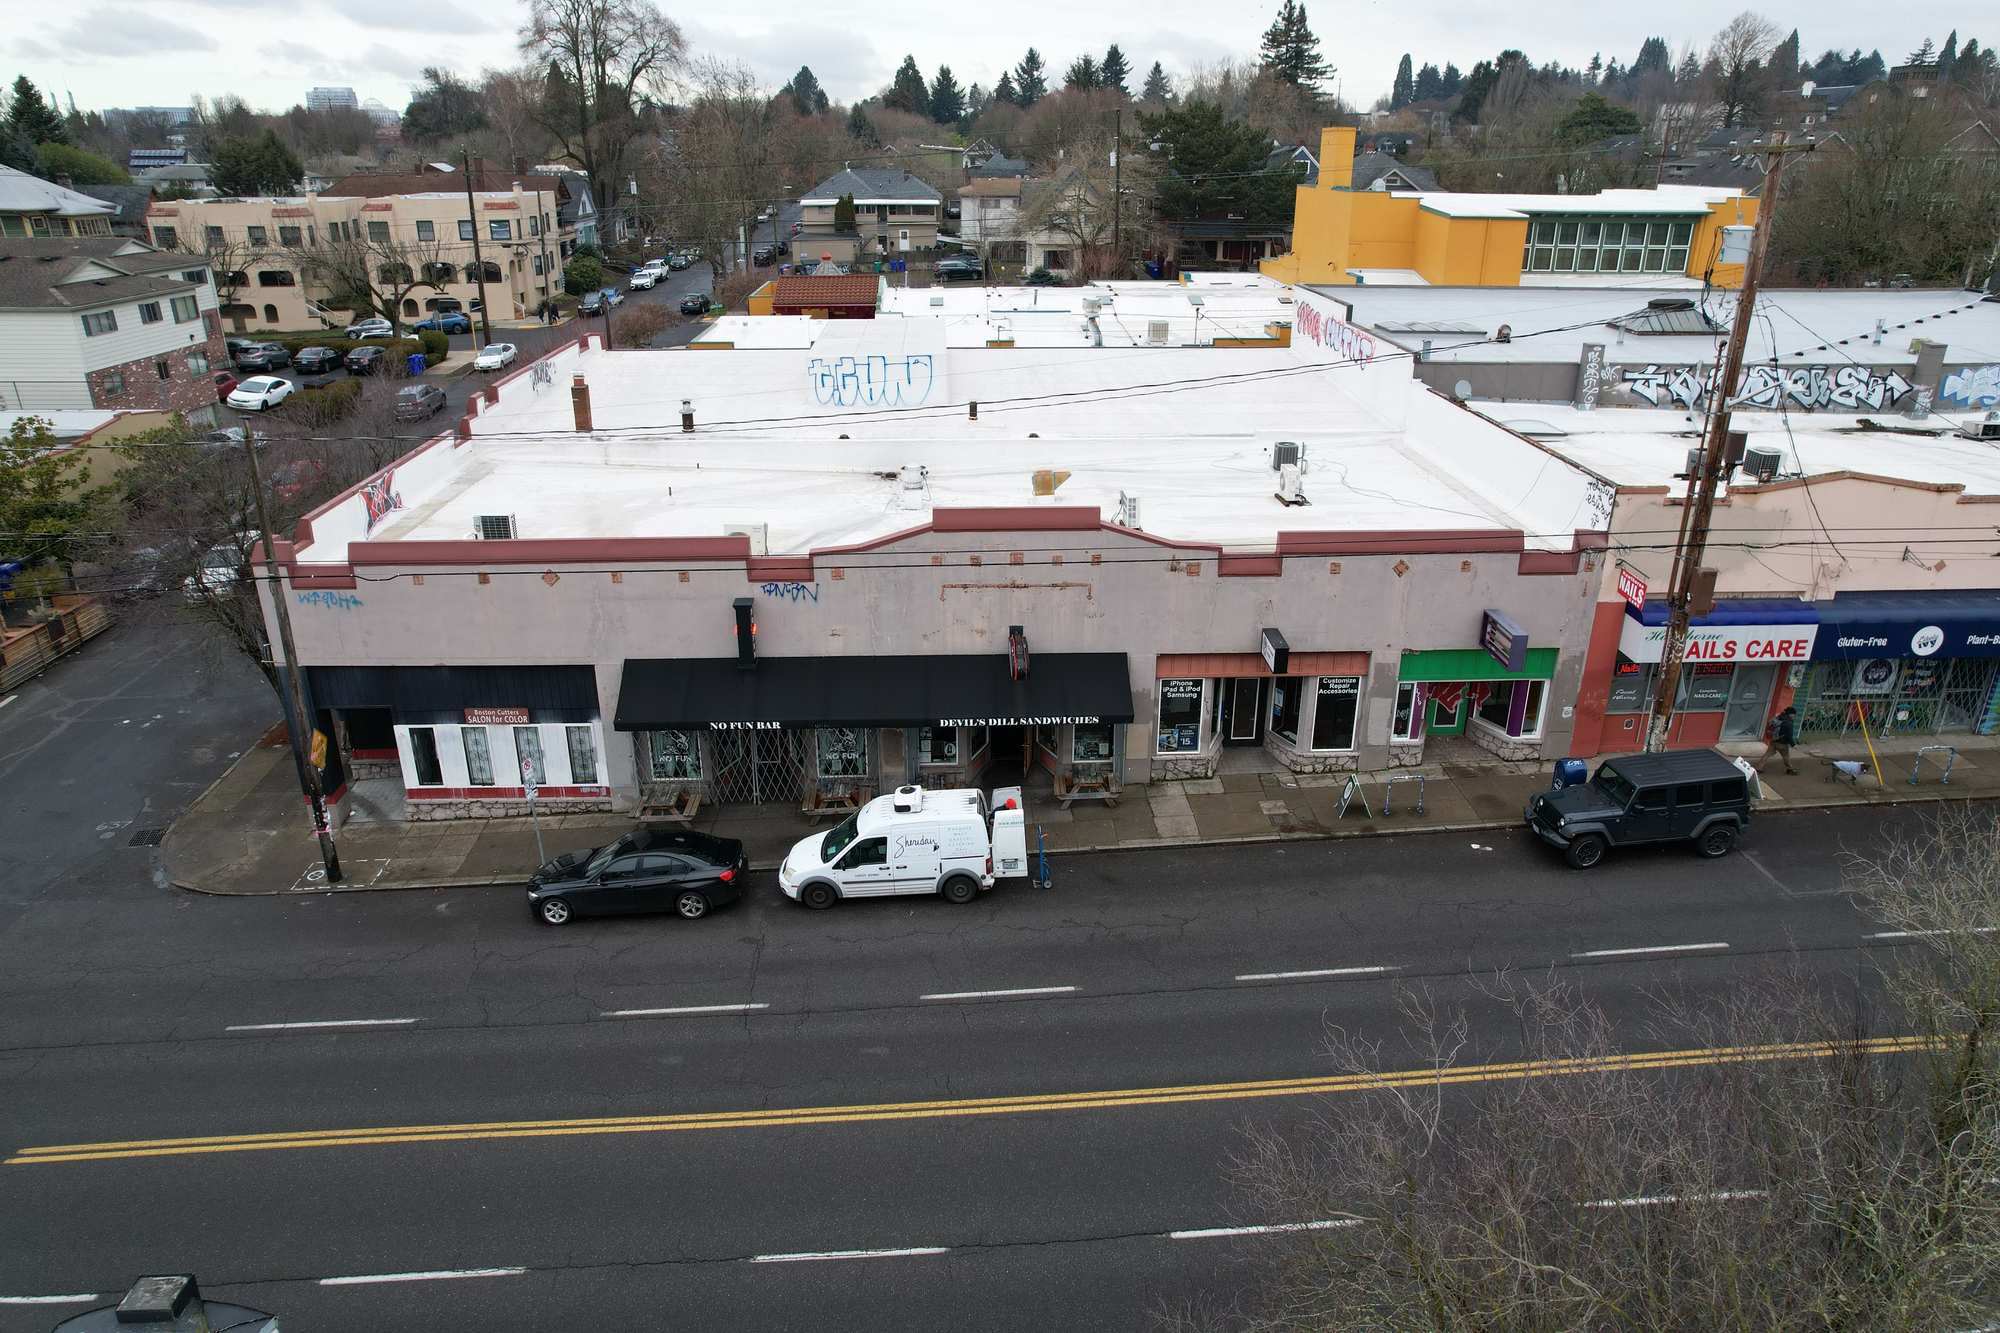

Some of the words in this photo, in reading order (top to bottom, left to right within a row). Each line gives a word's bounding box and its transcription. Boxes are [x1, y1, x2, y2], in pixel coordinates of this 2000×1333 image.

[1619, 575, 1645, 604] NAILS
[1837, 636, 1888, 647] Gluten-Free
[1685, 640, 1738, 659] AILS
[1745, 640, 1808, 658] CARE
[467, 715, 491, 723] SALON
[493, 715, 503, 723] for
[504, 715, 528, 723] COLOR
[940, 718, 986, 727] DEVIL'S
[988, 717, 1018, 726] DILL
[1019, 716, 1100, 725] SANDWICHES
[710, 722, 727, 730] NO
[730, 721, 754, 729] FUN
[756, 721, 781, 729] BAR
